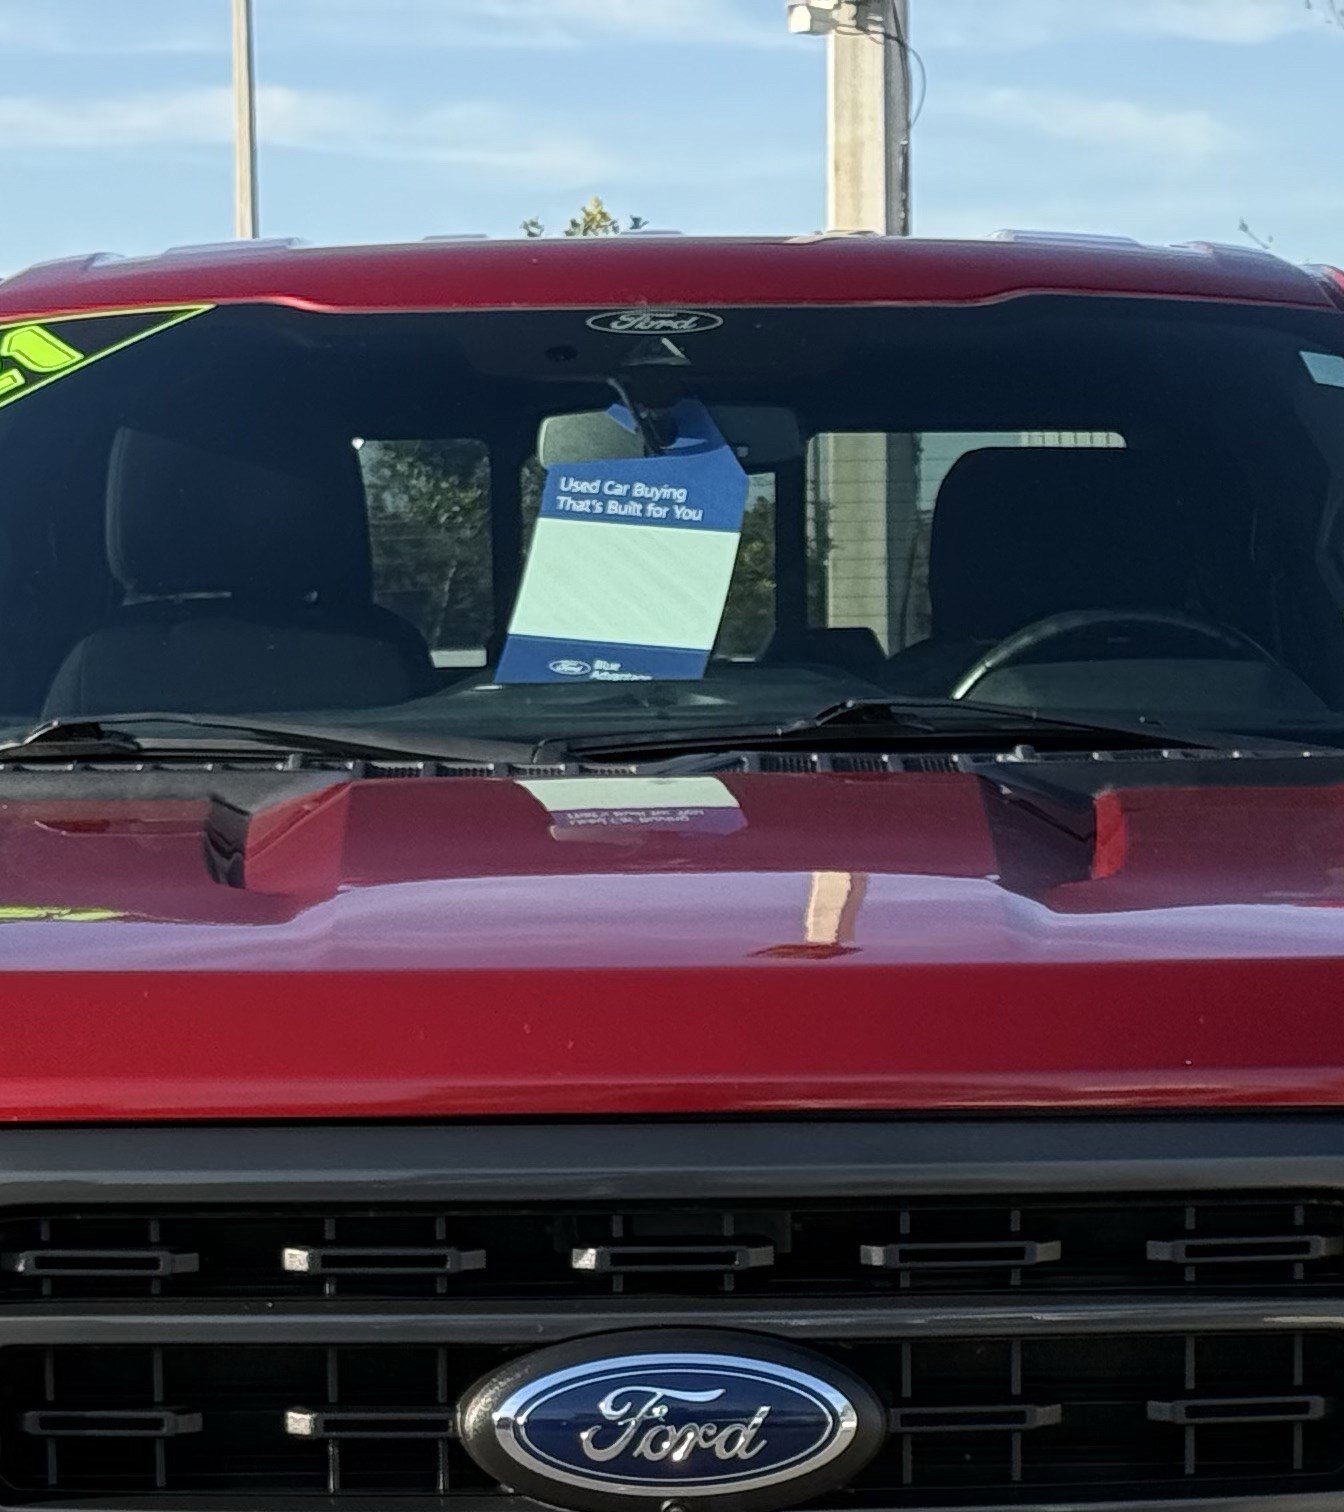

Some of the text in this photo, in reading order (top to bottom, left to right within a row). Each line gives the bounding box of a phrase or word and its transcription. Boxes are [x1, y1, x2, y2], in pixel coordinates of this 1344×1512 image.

[610, 313, 699, 330] Ford
[559, 476, 688, 503] Used Car Buying
[556, 496, 704, 521] That's Built for You
[582, 1385, 772, 1462] Ford
